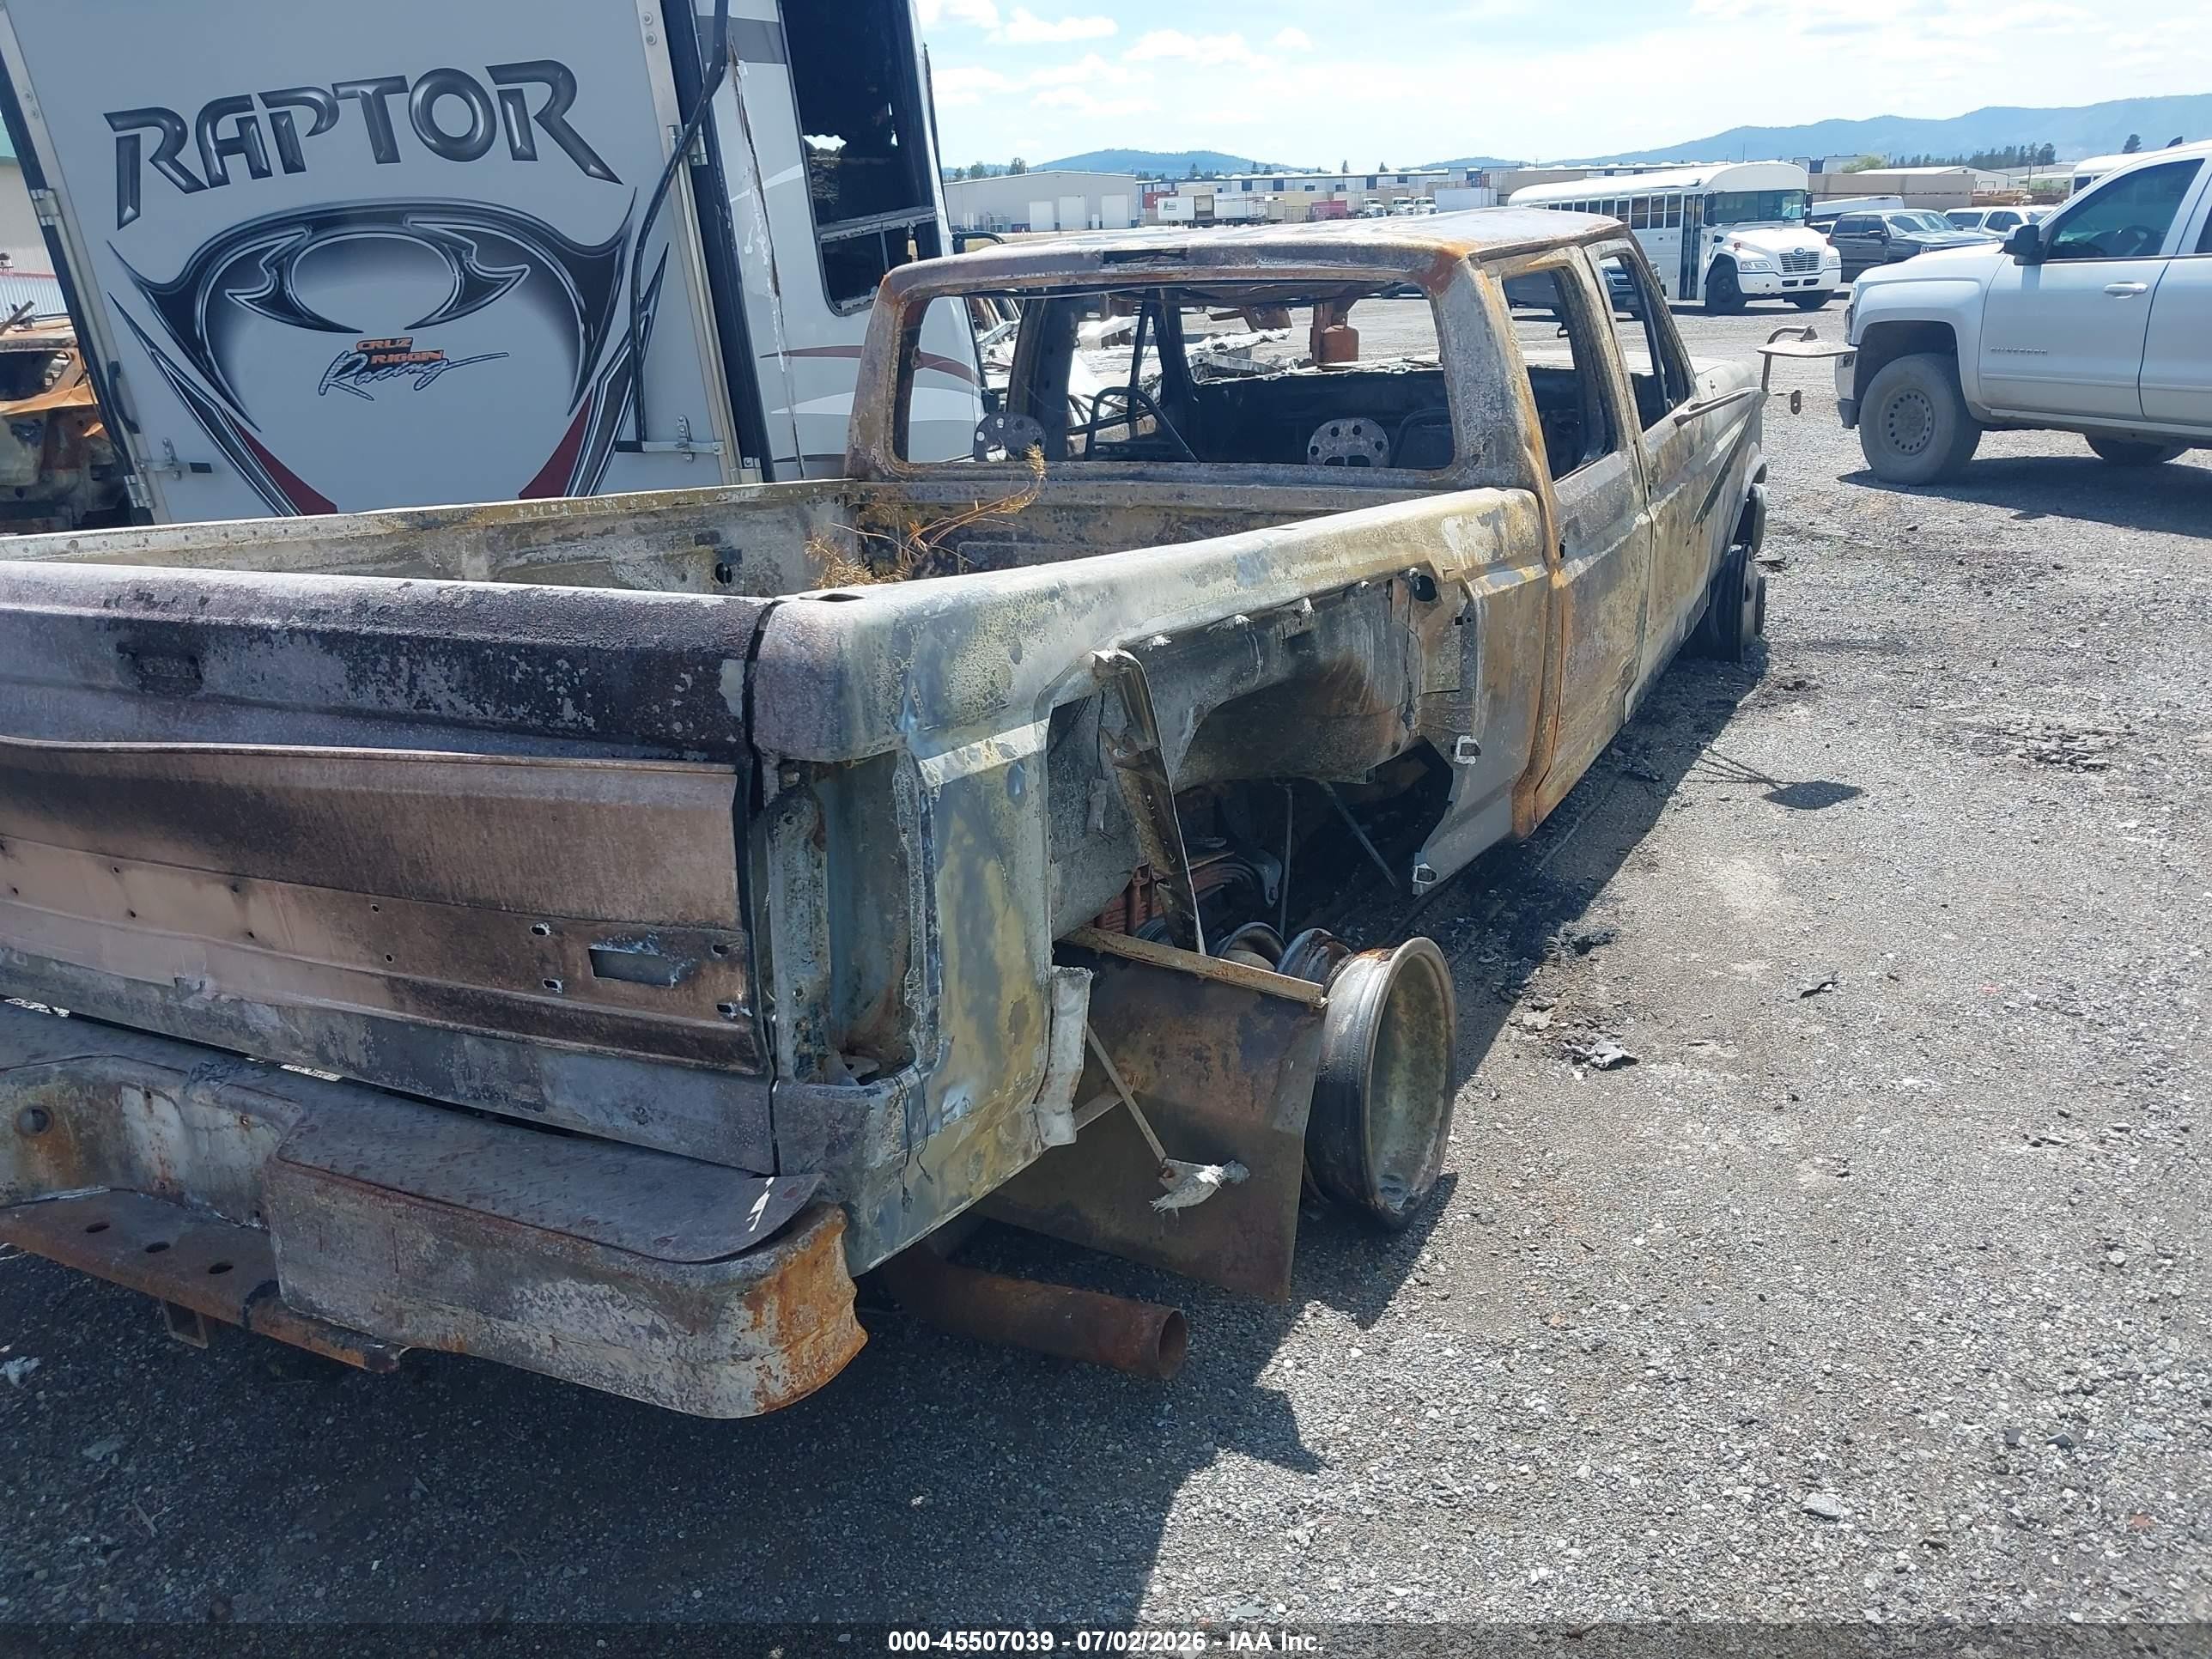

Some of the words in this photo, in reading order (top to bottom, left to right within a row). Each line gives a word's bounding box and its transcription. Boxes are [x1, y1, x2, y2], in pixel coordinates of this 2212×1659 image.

[103, 58, 623, 231] RAPTOR
[356, 337, 413, 353] CRUZ
[318, 349, 509, 402] Racing
